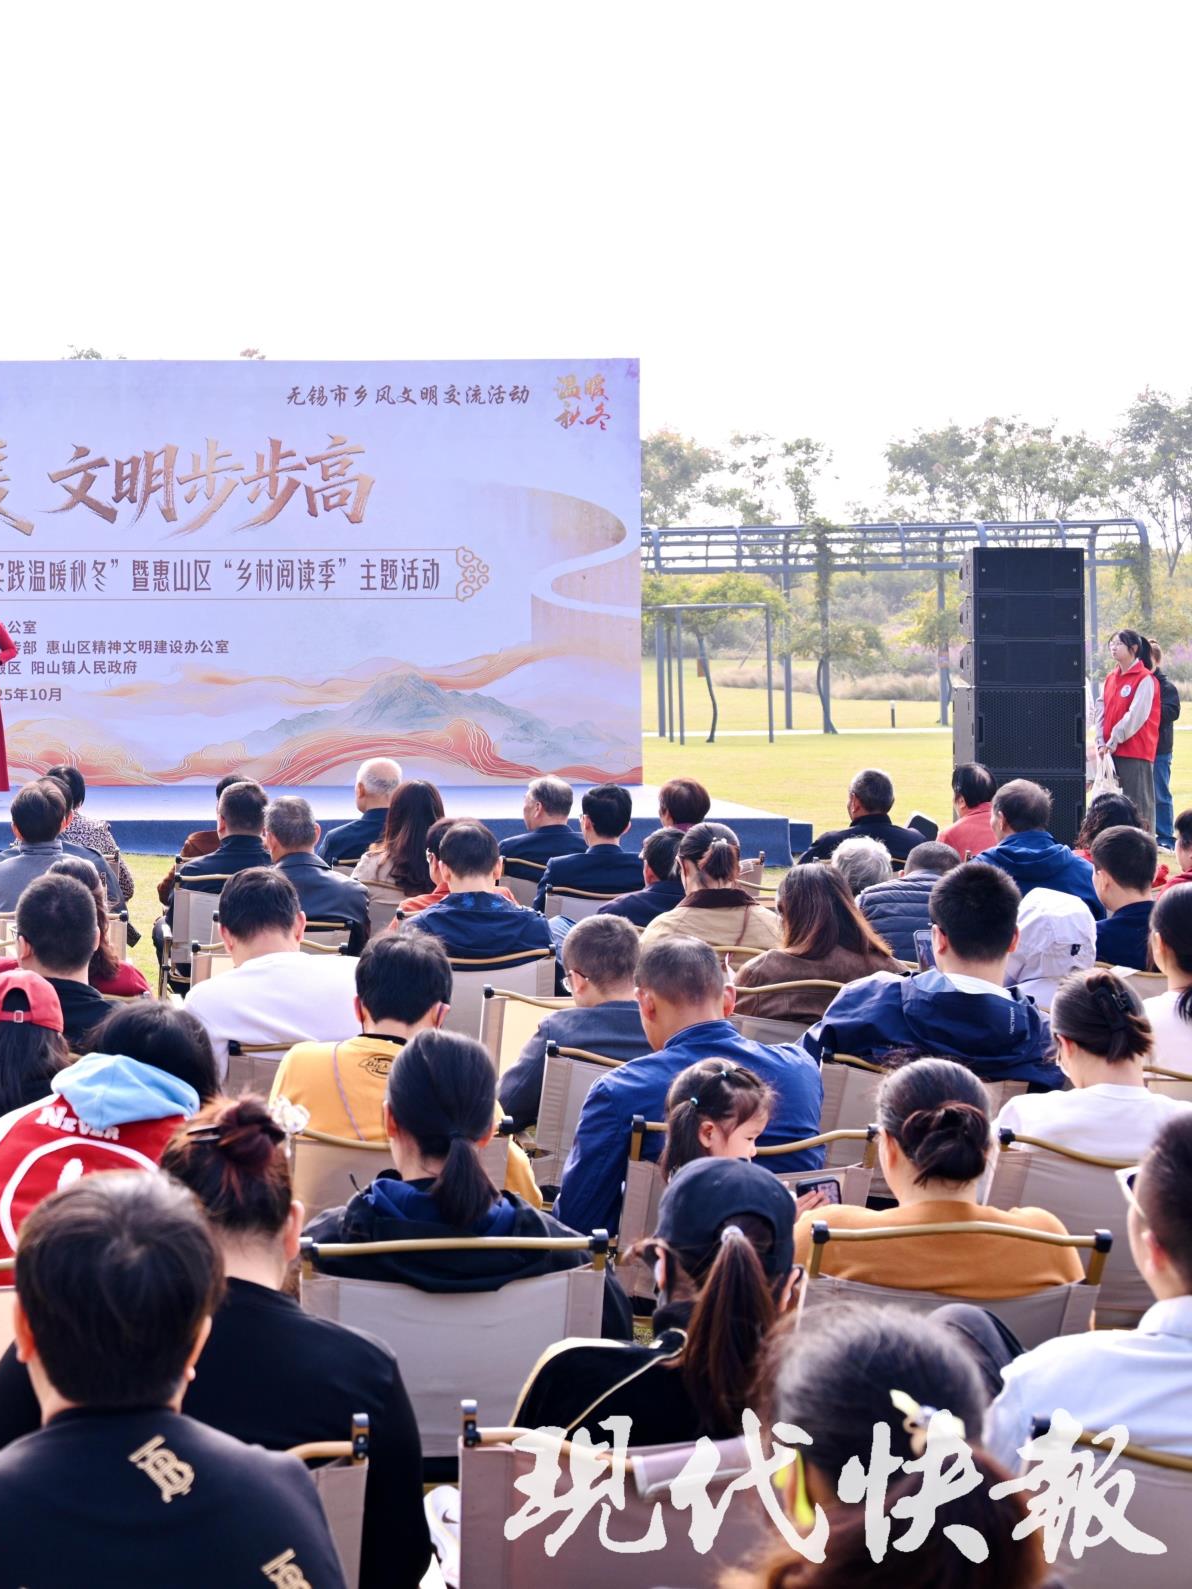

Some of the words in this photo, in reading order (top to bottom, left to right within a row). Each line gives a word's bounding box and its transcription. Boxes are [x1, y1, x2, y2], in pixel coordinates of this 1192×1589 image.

[286, 384, 531, 408] 无锡市乡风文明交流活动
[38, 433, 375, 540] 文明步步高
[46, 640, 230, 654] 惠山区精神文明建设办公室
[31, 660, 138, 675] 阳山镇人民政府
